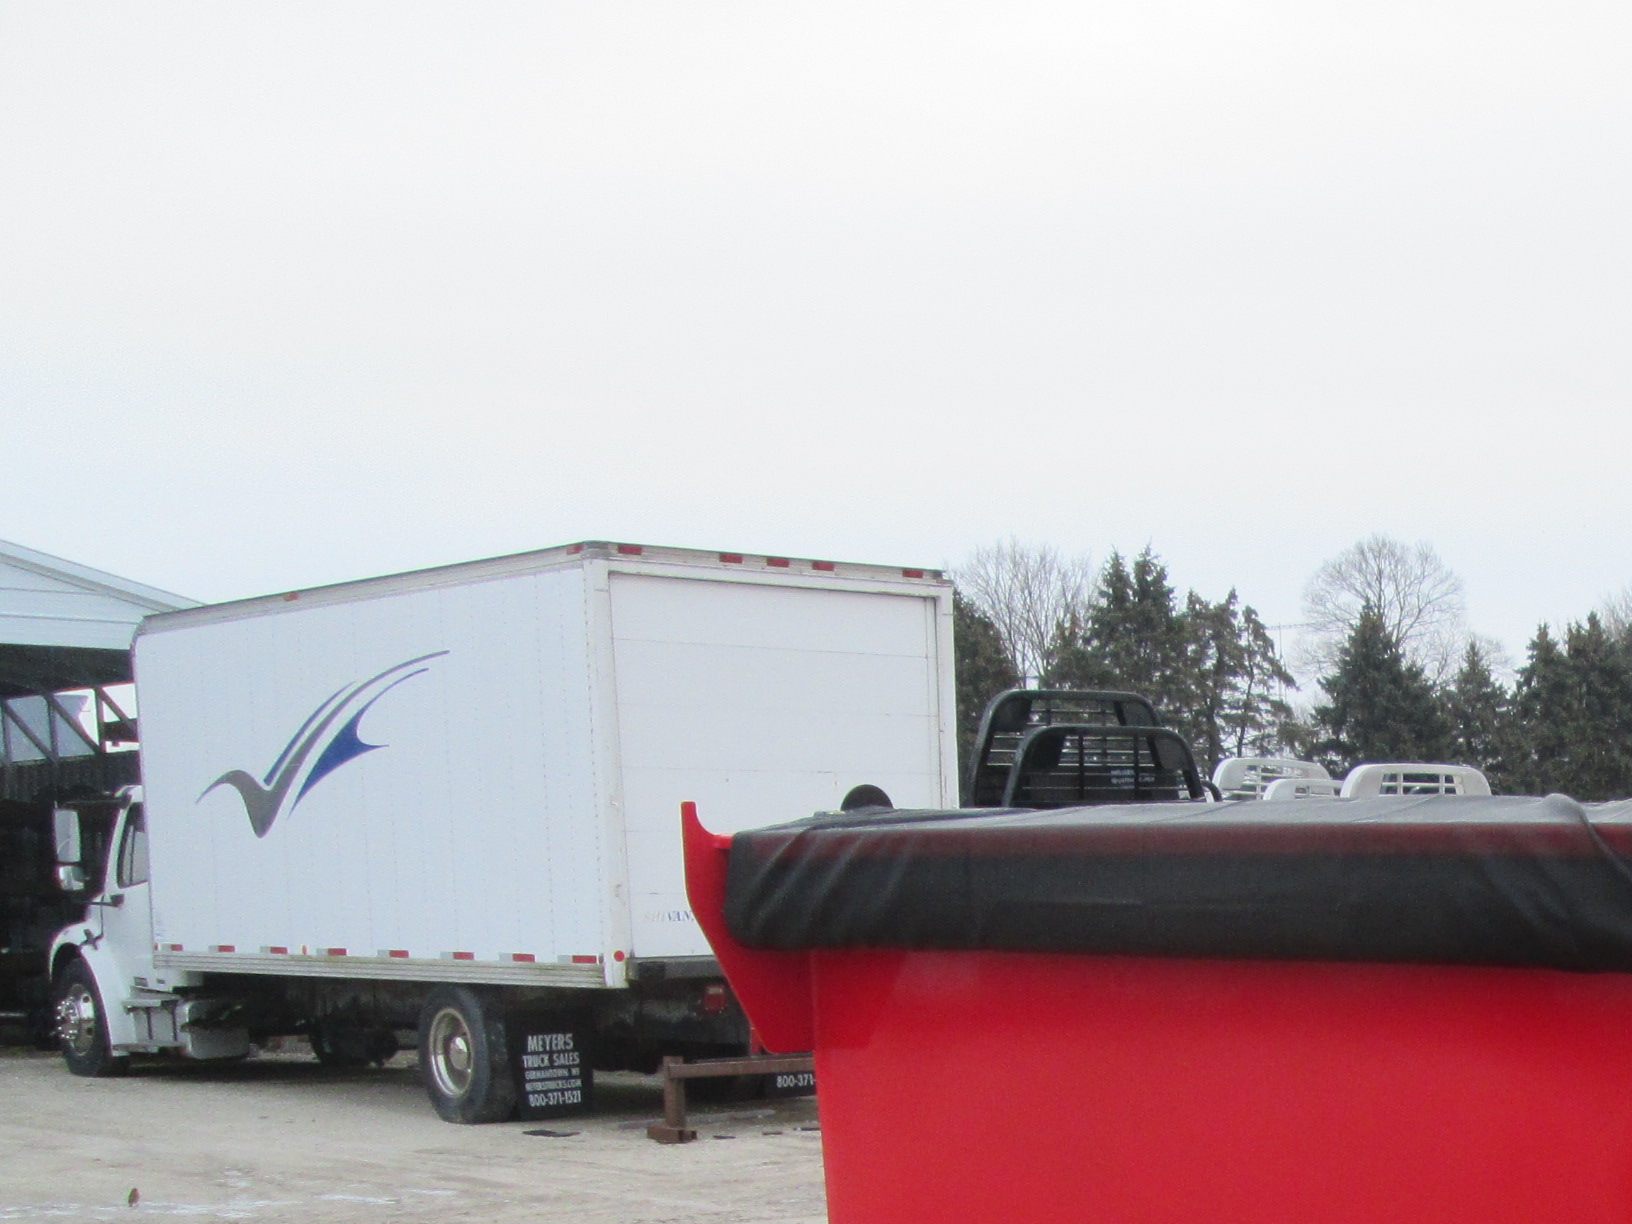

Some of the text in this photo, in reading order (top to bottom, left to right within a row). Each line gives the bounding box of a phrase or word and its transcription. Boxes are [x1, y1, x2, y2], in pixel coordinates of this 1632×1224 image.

[527, 1032, 574, 1053] MEYERS
[522, 1052, 580, 1069] TRUCK SALES
[528, 1090, 582, 1107] 800-371-1521
